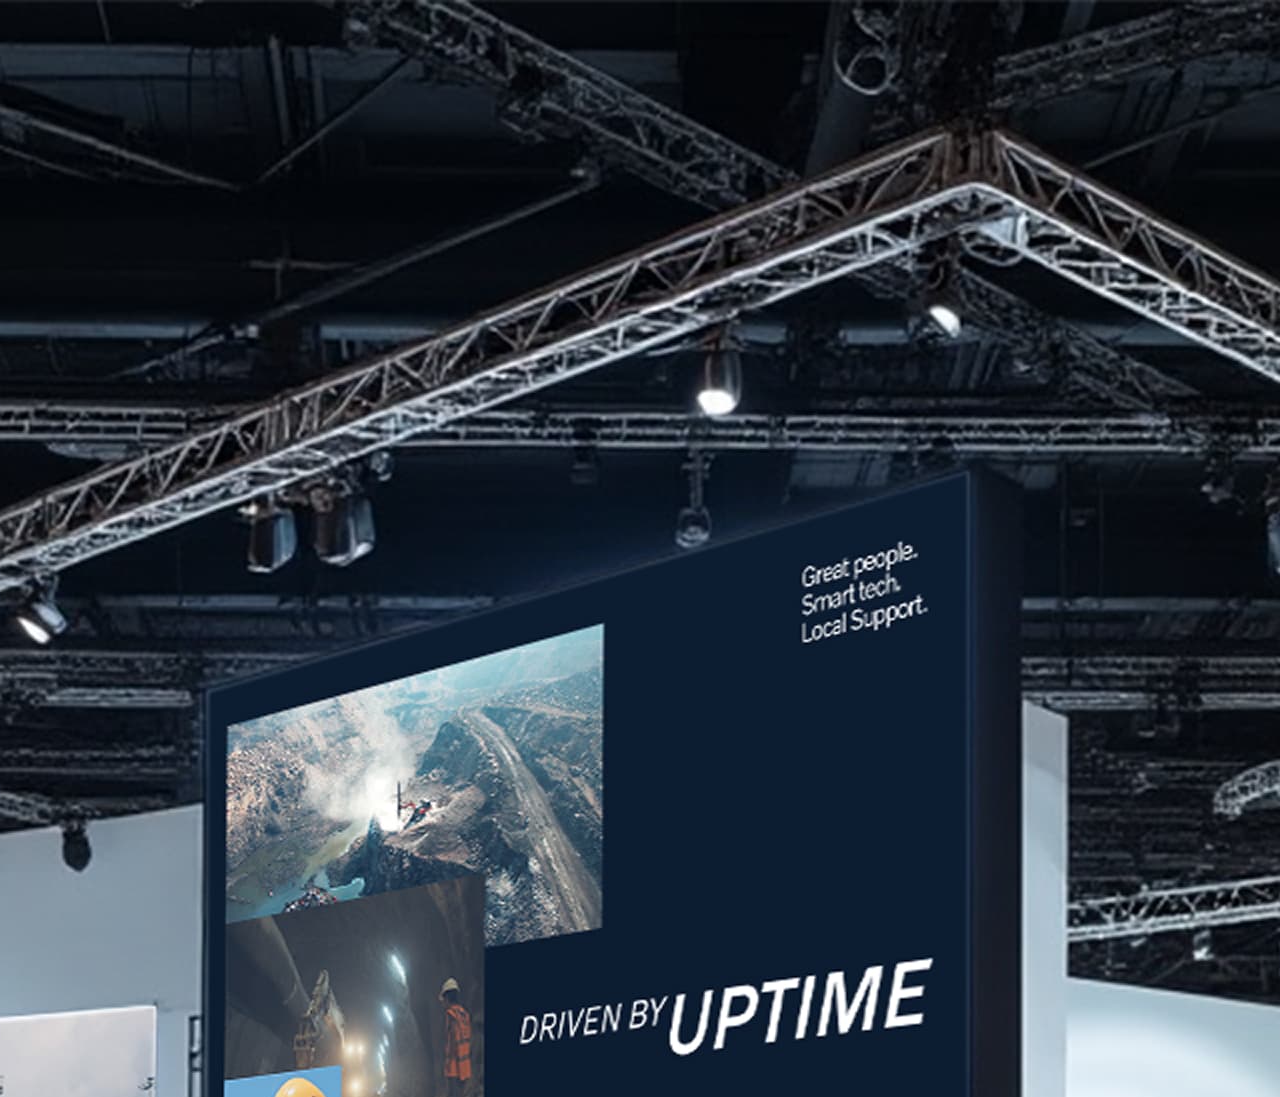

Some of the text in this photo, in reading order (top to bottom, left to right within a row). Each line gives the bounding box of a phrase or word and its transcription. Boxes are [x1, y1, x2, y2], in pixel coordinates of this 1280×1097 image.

[801, 541, 918, 588] Great people.
[802, 572, 901, 616] Smart tech.
[801, 595, 928, 643] Local Support.
[519, 958, 933, 1056] DRIVEN BY UPTIME
